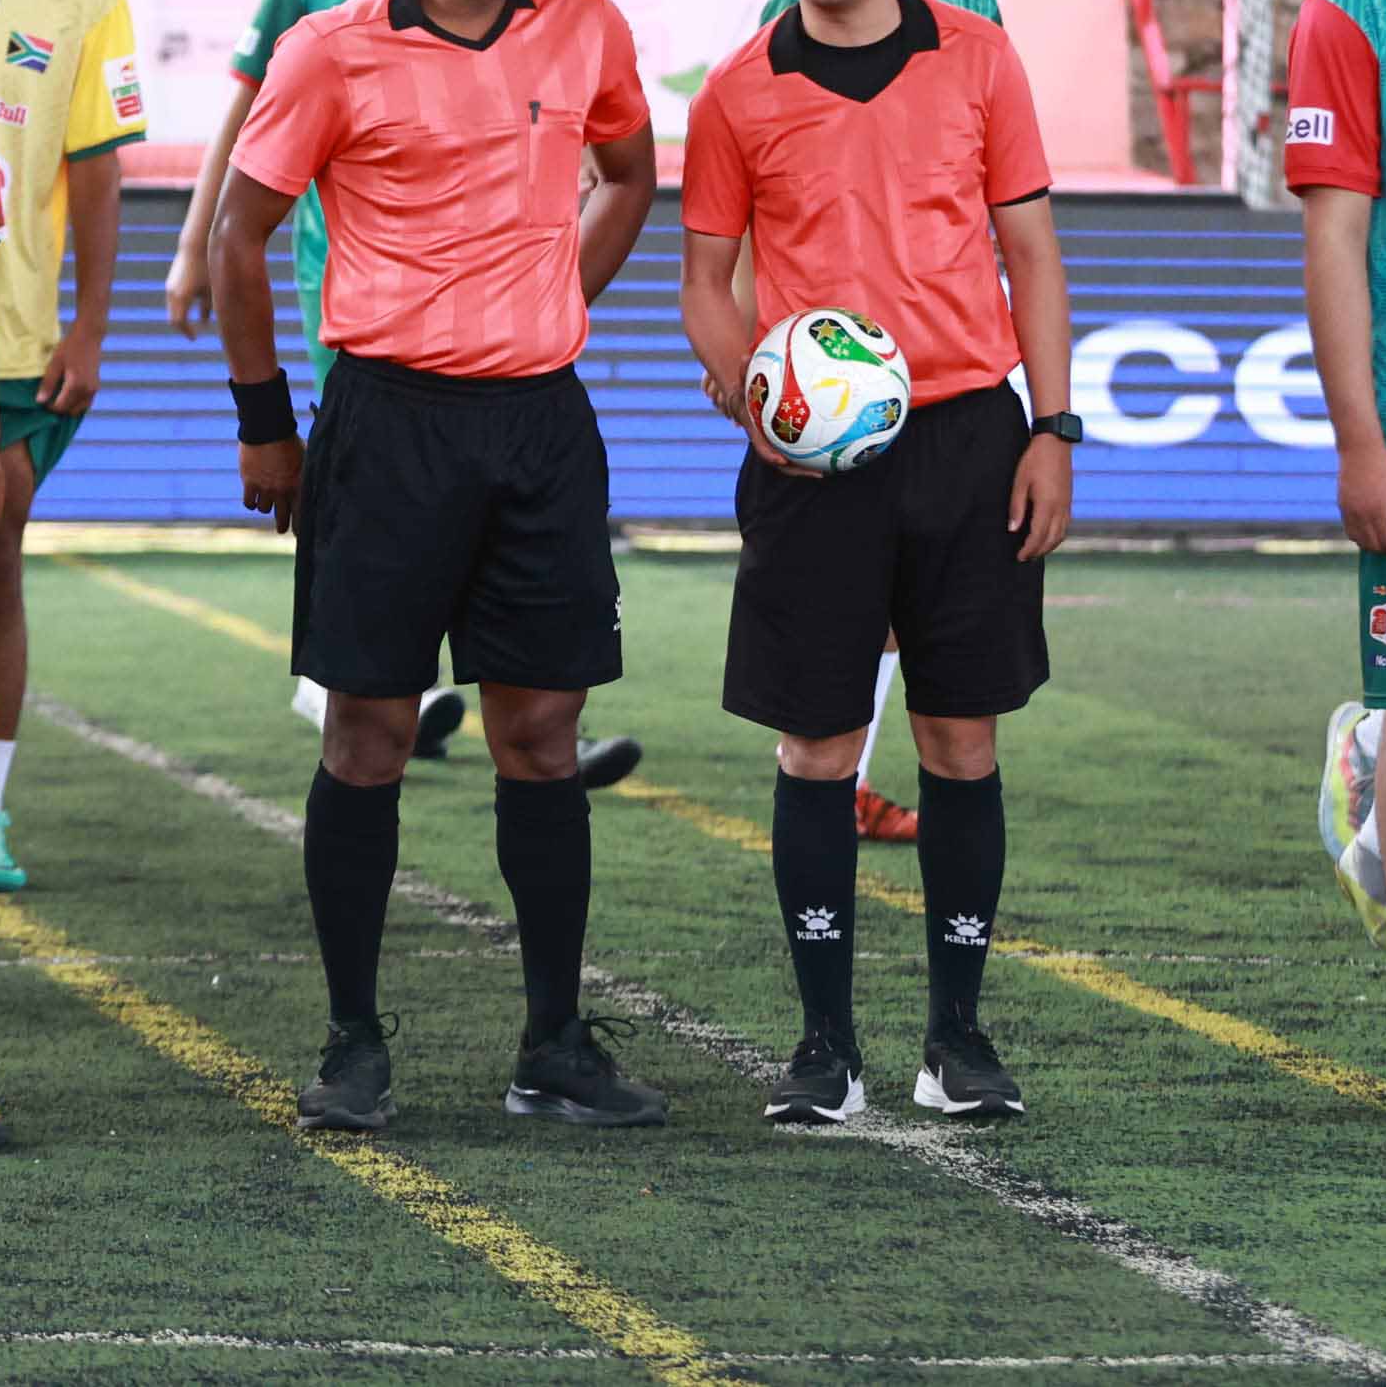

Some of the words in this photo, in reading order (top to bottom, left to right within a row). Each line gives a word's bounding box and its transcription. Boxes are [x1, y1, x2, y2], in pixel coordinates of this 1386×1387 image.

[1286, 114, 1328, 139] ell
[796, 929, 842, 941] KELME
[944, 933, 988, 946] KELME
